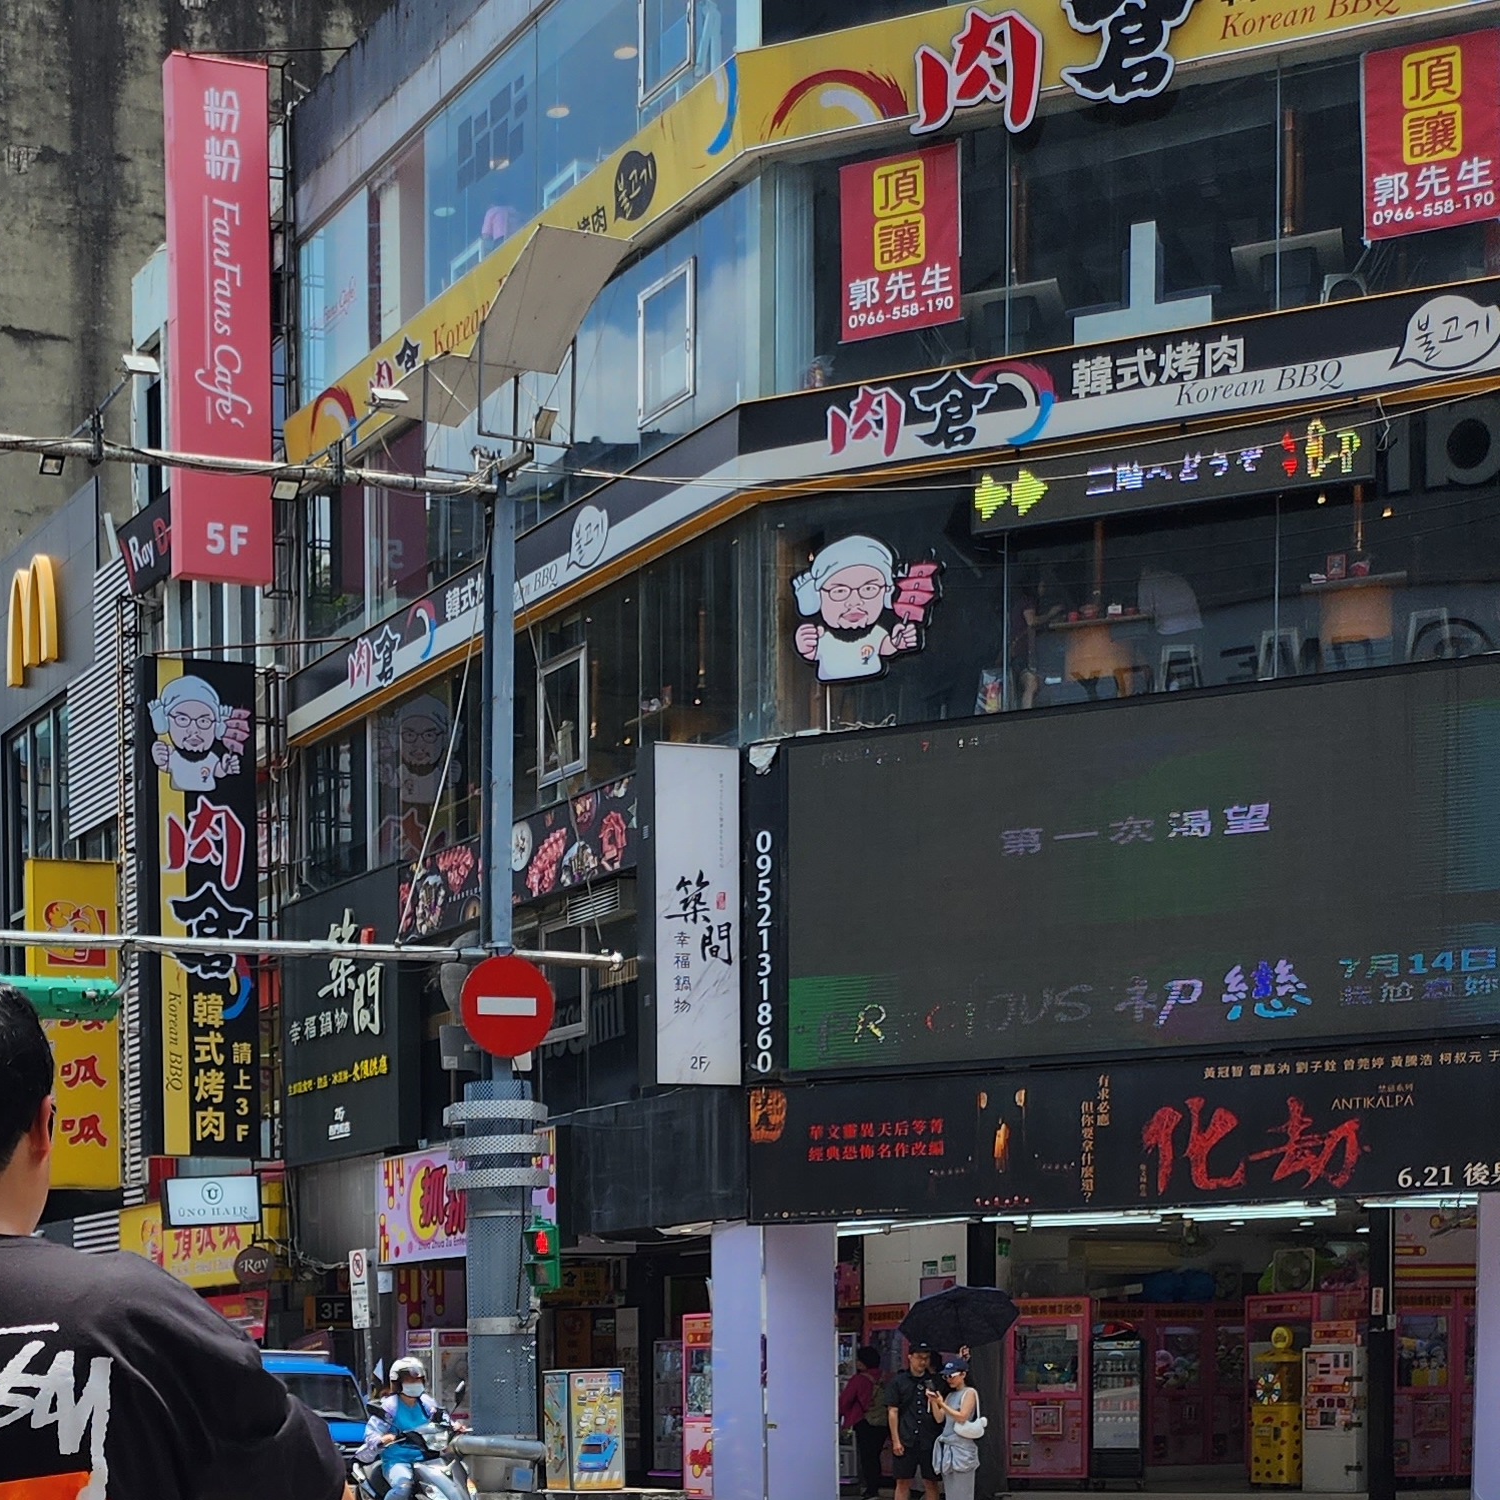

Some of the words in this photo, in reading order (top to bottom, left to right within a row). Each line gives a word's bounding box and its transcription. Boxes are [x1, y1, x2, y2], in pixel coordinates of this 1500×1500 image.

[1220, 7, 1315, 41] Korean
[1407, 51, 1457, 159] 頂讓
[1373, 157, 1493, 207] 郭先生
[878, 165, 921, 265] 頂讓
[1372, 190, 1495, 226] 0966-558-190
[211, 197, 242, 336] FanFans
[848, 263, 953, 311] 郭先生
[848, 296, 954, 329] 0966-558-190
[1415, 314, 1492, 358] 불고기
[195, 344, 252, 429] Café
[1071, 335, 1245, 399] 韓式烤肉
[1175, 374, 1266, 407] Korean
[1276, 359, 1345, 393] BBQ
[128, 535, 155, 573] Ray
[206, 522, 249, 556] 5F
[533, 563, 559, 590] BBQ
[1000, 803, 1271, 857] 第一次渴望
[665, 869, 733, 967] 築間
[673, 930, 693, 1015] 幸福鍋物
[755, 830, 773, 1074] 0952131860
[167, 989, 183, 1051] Korean
[288, 1006, 349, 1046] 幸福鍋物
[58, 1018, 108, 1149] 呱呱
[165, 1051, 184, 1093] BBQ
[193, 991, 226, 1143] 韓式烤肉
[1202, 1065, 1244, 1080] 黃冠智
[1438, 1050, 1482, 1065] 柯叔元
[231, 1040, 253, 1143] 請上3F
[1095, 1074, 1111, 1127] 有求必應
[1331, 1092, 1414, 1111] ANTIKALPA
[808, 1140, 945, 1163] 經典恐怖名作改編
[1142, 1095, 1372, 1196] 化劫
[1398, 1164, 1454, 1188] 6.21
[238, 1255, 270, 1279] Ray
[320, 1302, 345, 1319] 3F
